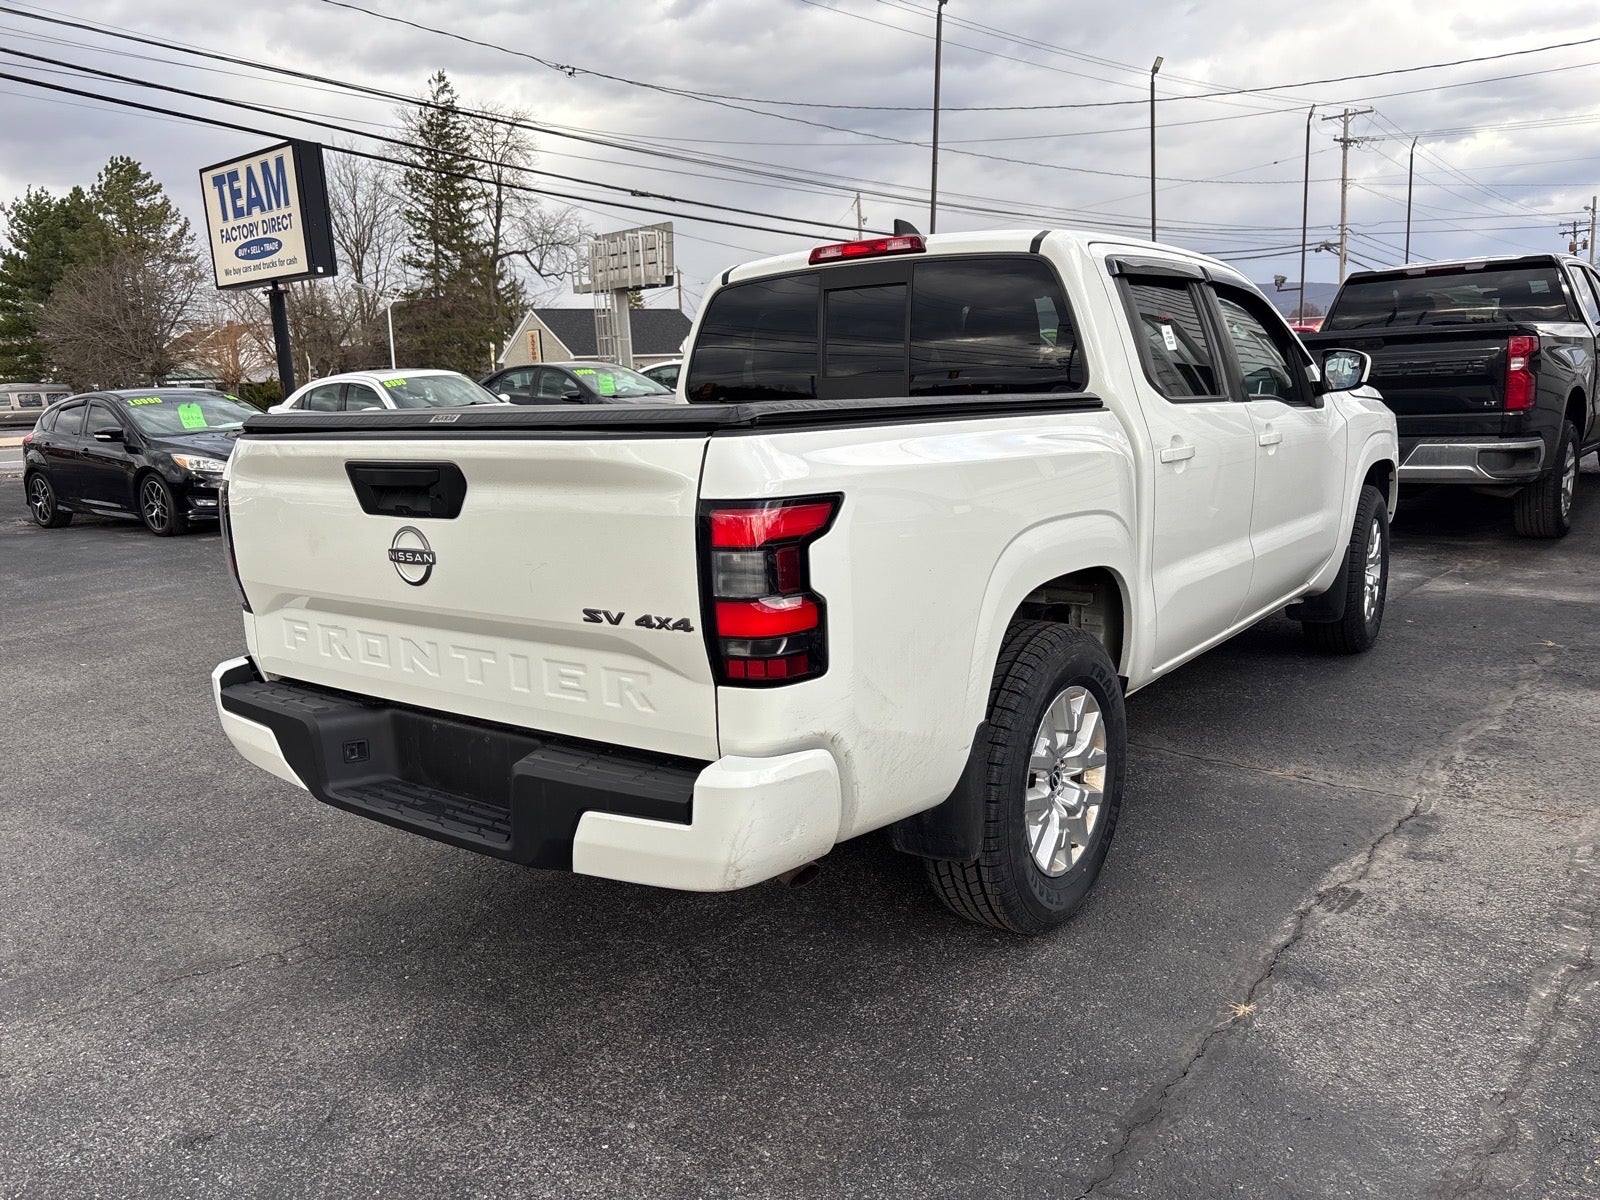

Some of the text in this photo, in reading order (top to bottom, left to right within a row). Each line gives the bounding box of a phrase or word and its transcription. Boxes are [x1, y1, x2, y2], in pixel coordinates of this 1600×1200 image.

[212, 155, 291, 223] TEAM
[220, 213, 293, 244] FACTORY DIRECT
[238, 241, 279, 257] BUY SELL TRADE
[224, 255, 298, 277] We buy cars and trucks for cash
[389, 550, 433, 563] NISSAN
[582, 608, 625, 626] SV
[282, 615, 657, 713] FRONTIER
